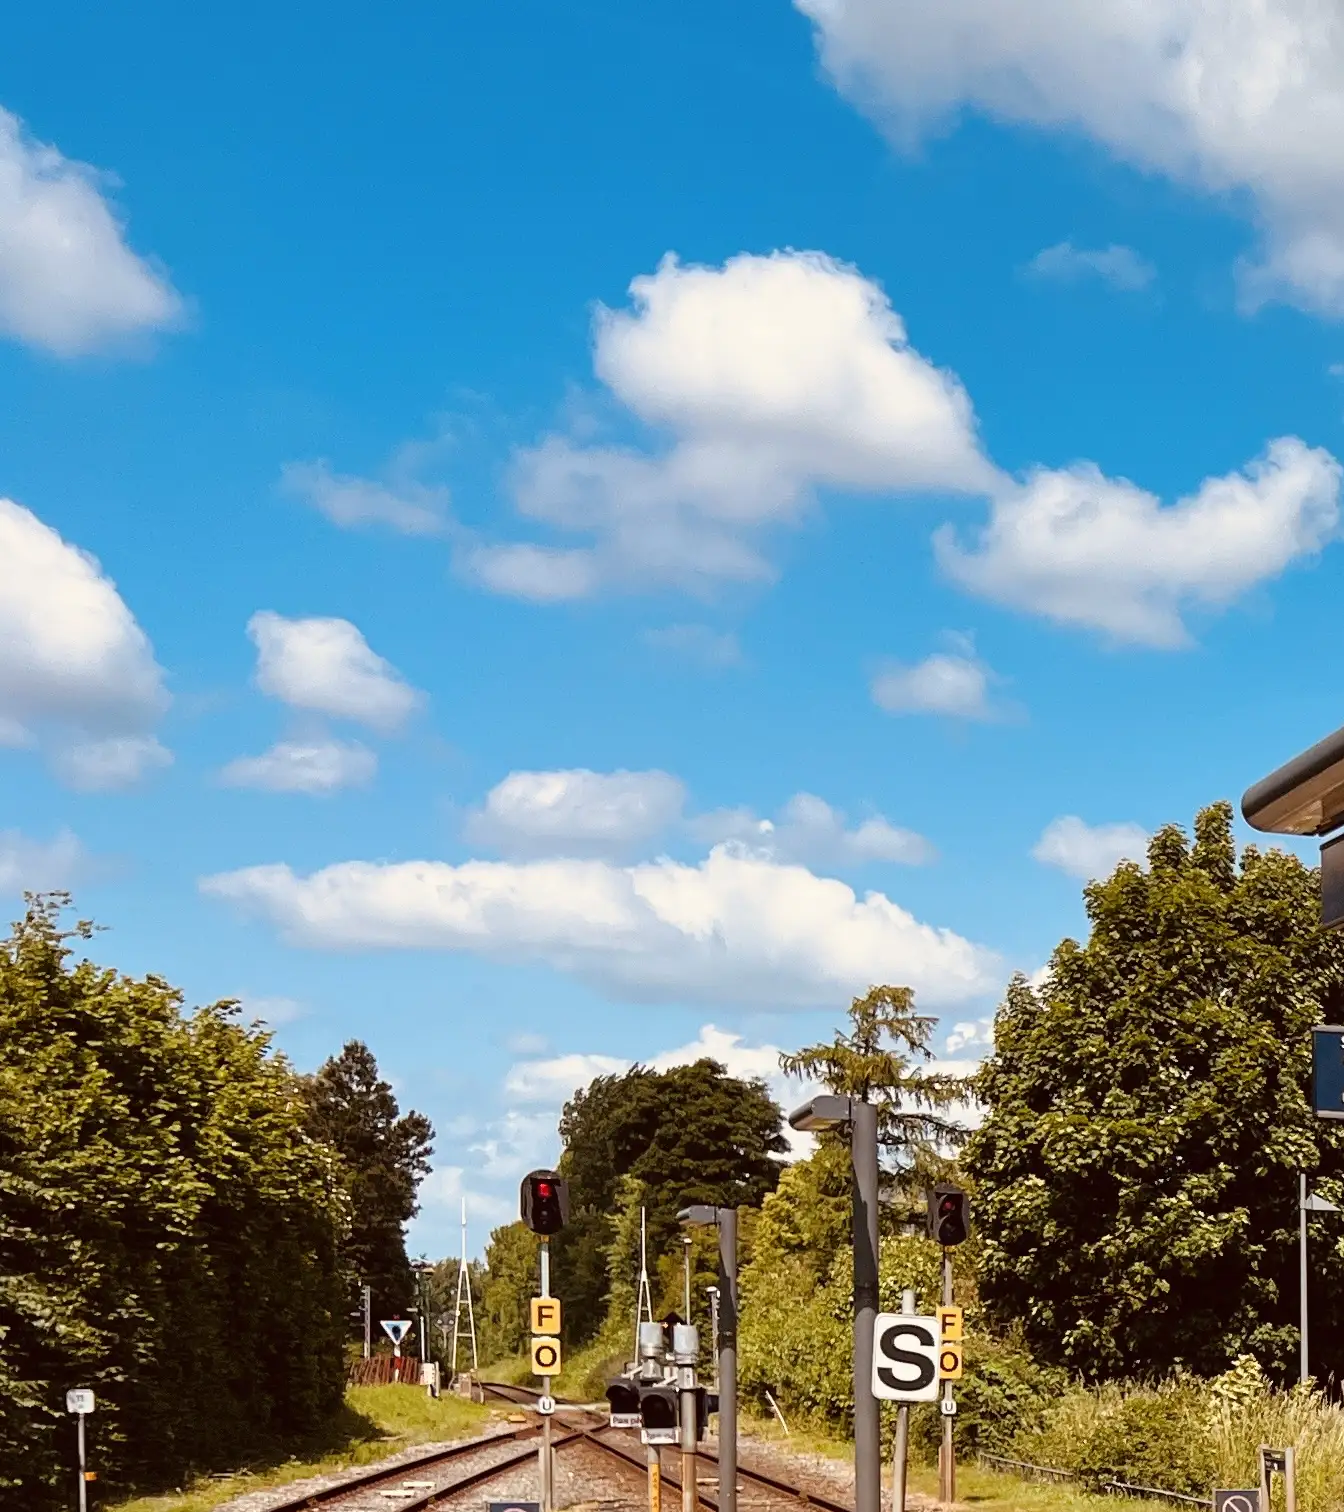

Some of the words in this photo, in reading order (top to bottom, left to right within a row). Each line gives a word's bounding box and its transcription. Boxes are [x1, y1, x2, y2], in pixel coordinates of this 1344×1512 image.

[538, 1305, 554, 1326] F
[942, 1314, 956, 1334] F
[535, 1345, 557, 1368] O
[877, 1324, 934, 1391] S
[940, 1351, 958, 1372] O
[542, 1400, 552, 1410] U
[944, 1402, 954, 1412] U
